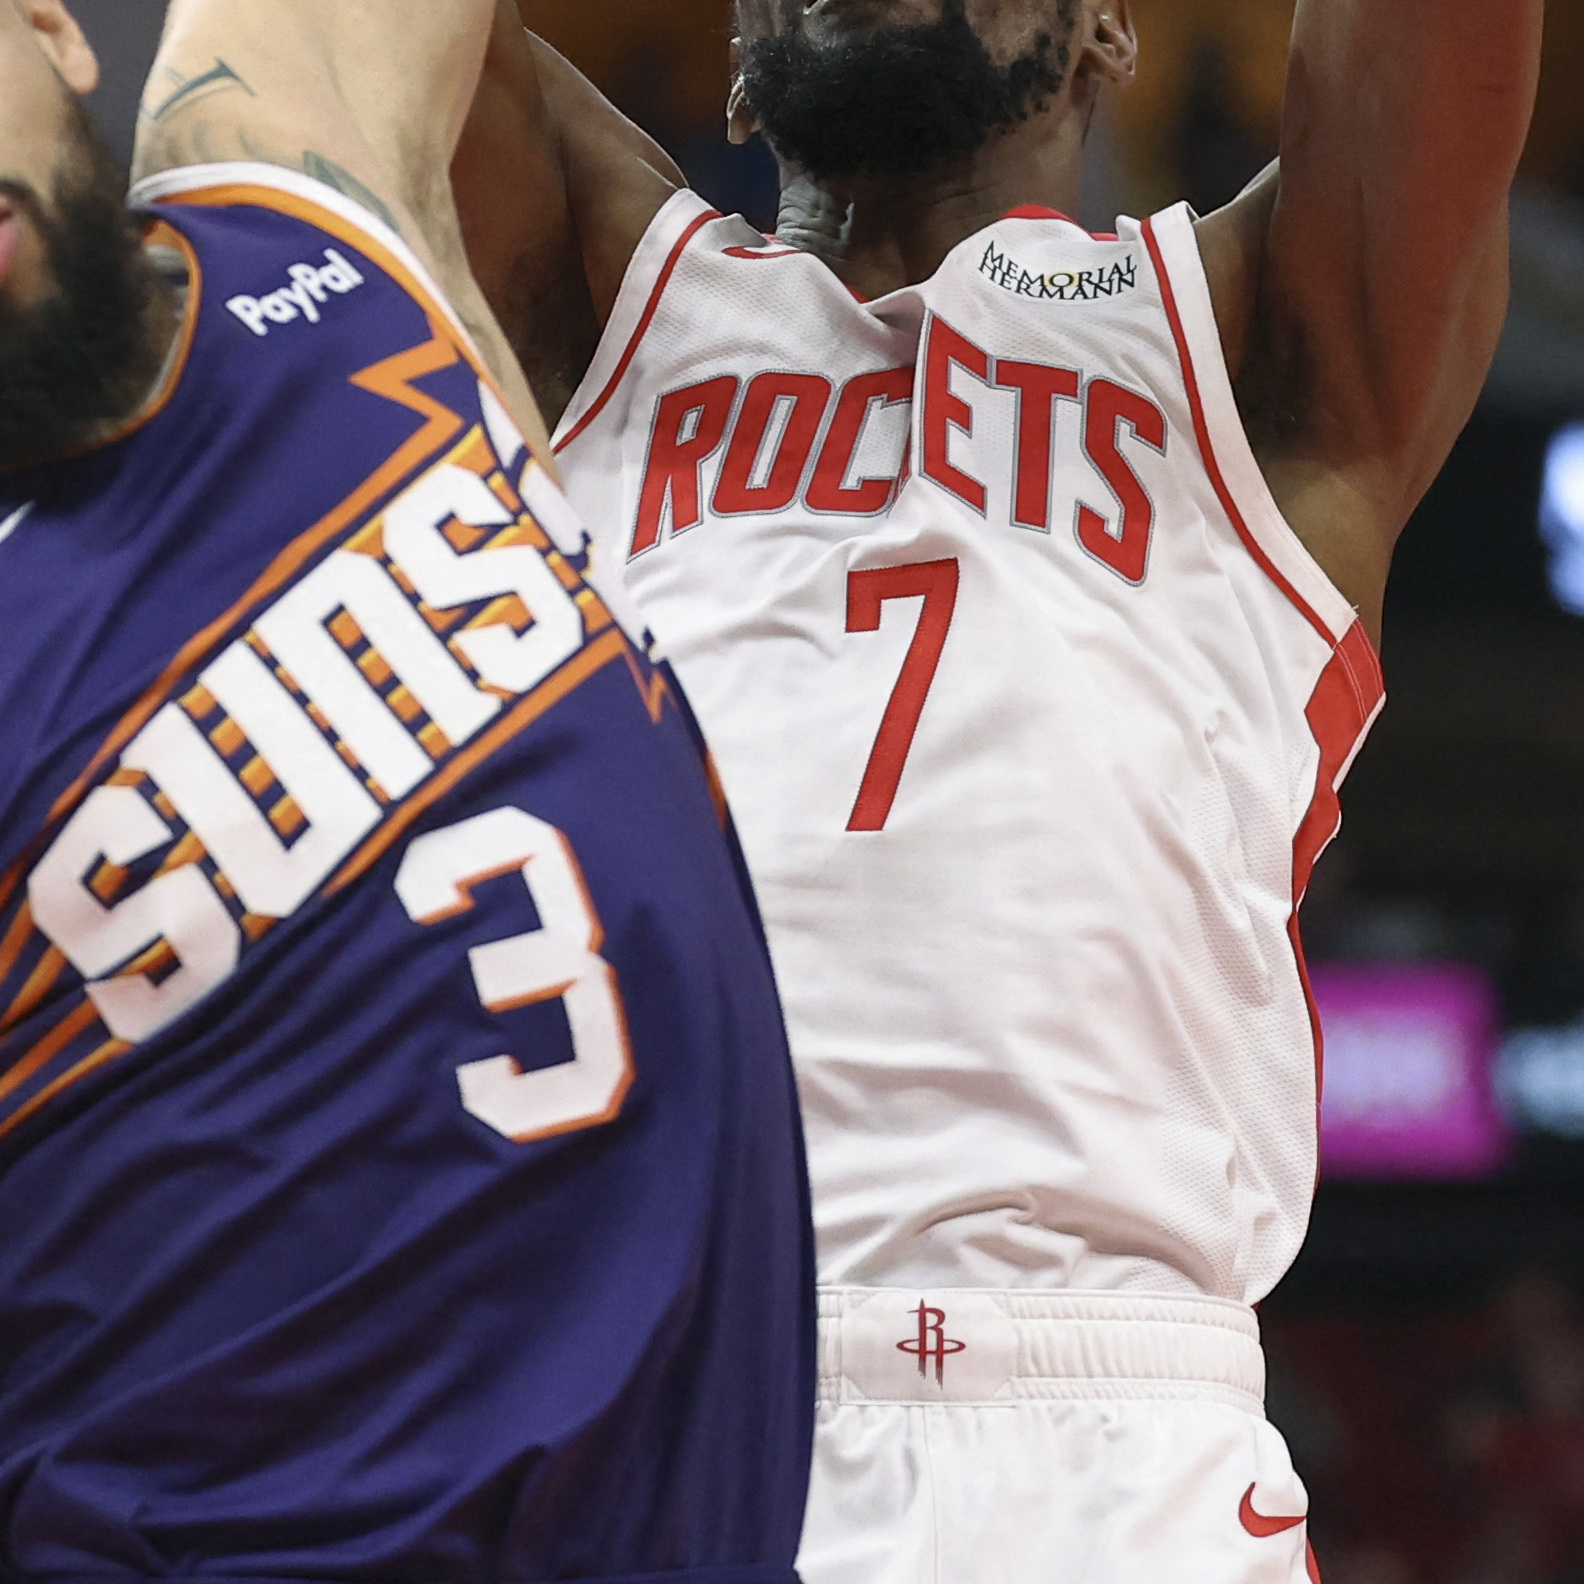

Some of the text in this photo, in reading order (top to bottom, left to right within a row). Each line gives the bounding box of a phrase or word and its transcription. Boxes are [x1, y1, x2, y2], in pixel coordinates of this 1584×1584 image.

[225, 247, 364, 336] PayPal
[978, 252, 1136, 300] HERMANN
[983, 240, 1138, 289] MEMORIAL
[625, 308, 1168, 588] ROCETS
[28, 461, 584, 1042] SUNS
[845, 557, 960, 832] 7
[393, 805, 634, 1144] 3
